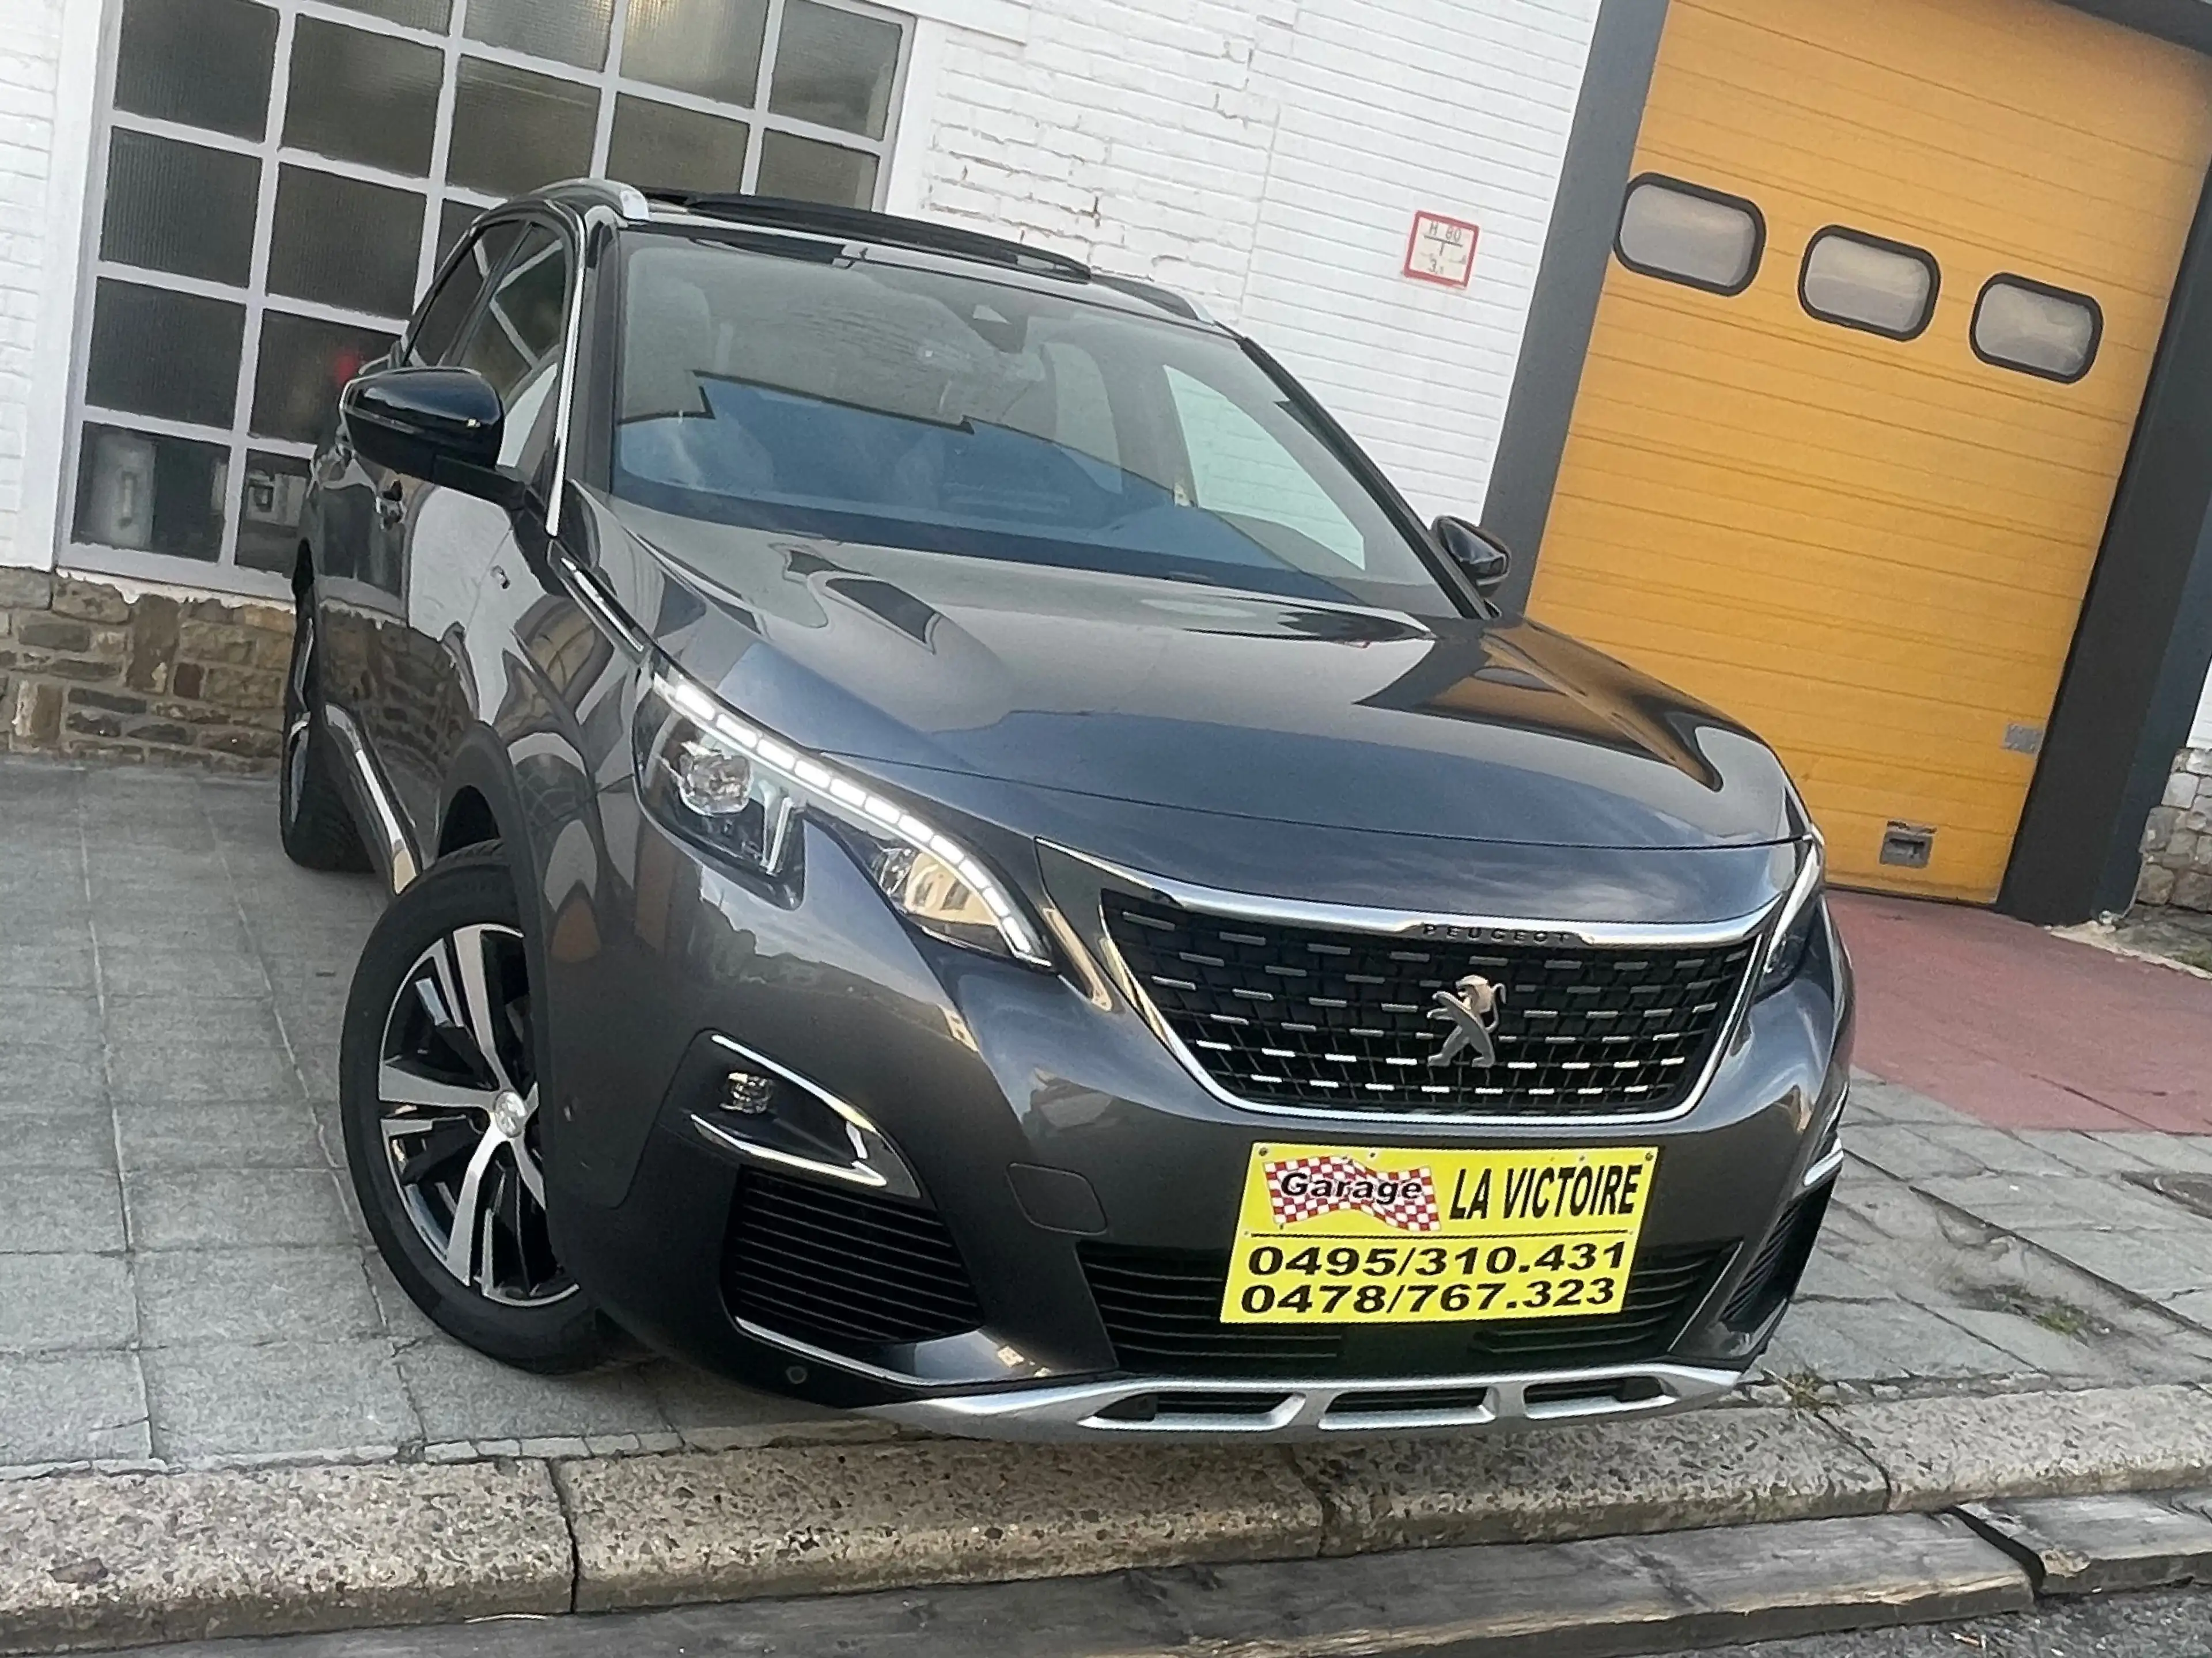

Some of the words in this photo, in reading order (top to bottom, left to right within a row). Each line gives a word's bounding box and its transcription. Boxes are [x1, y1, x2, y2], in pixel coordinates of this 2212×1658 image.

[1422, 923, 1570, 943] PEUGEOT
[1279, 1171, 1423, 1205] Garage
[1449, 1168, 1492, 1220] LA
[1502, 1163, 1643, 1219] VICTOIRE
[1247, 1240, 1626, 1277] 0495/310.431
[1240, 1277, 1615, 1314] 0478/767.323
